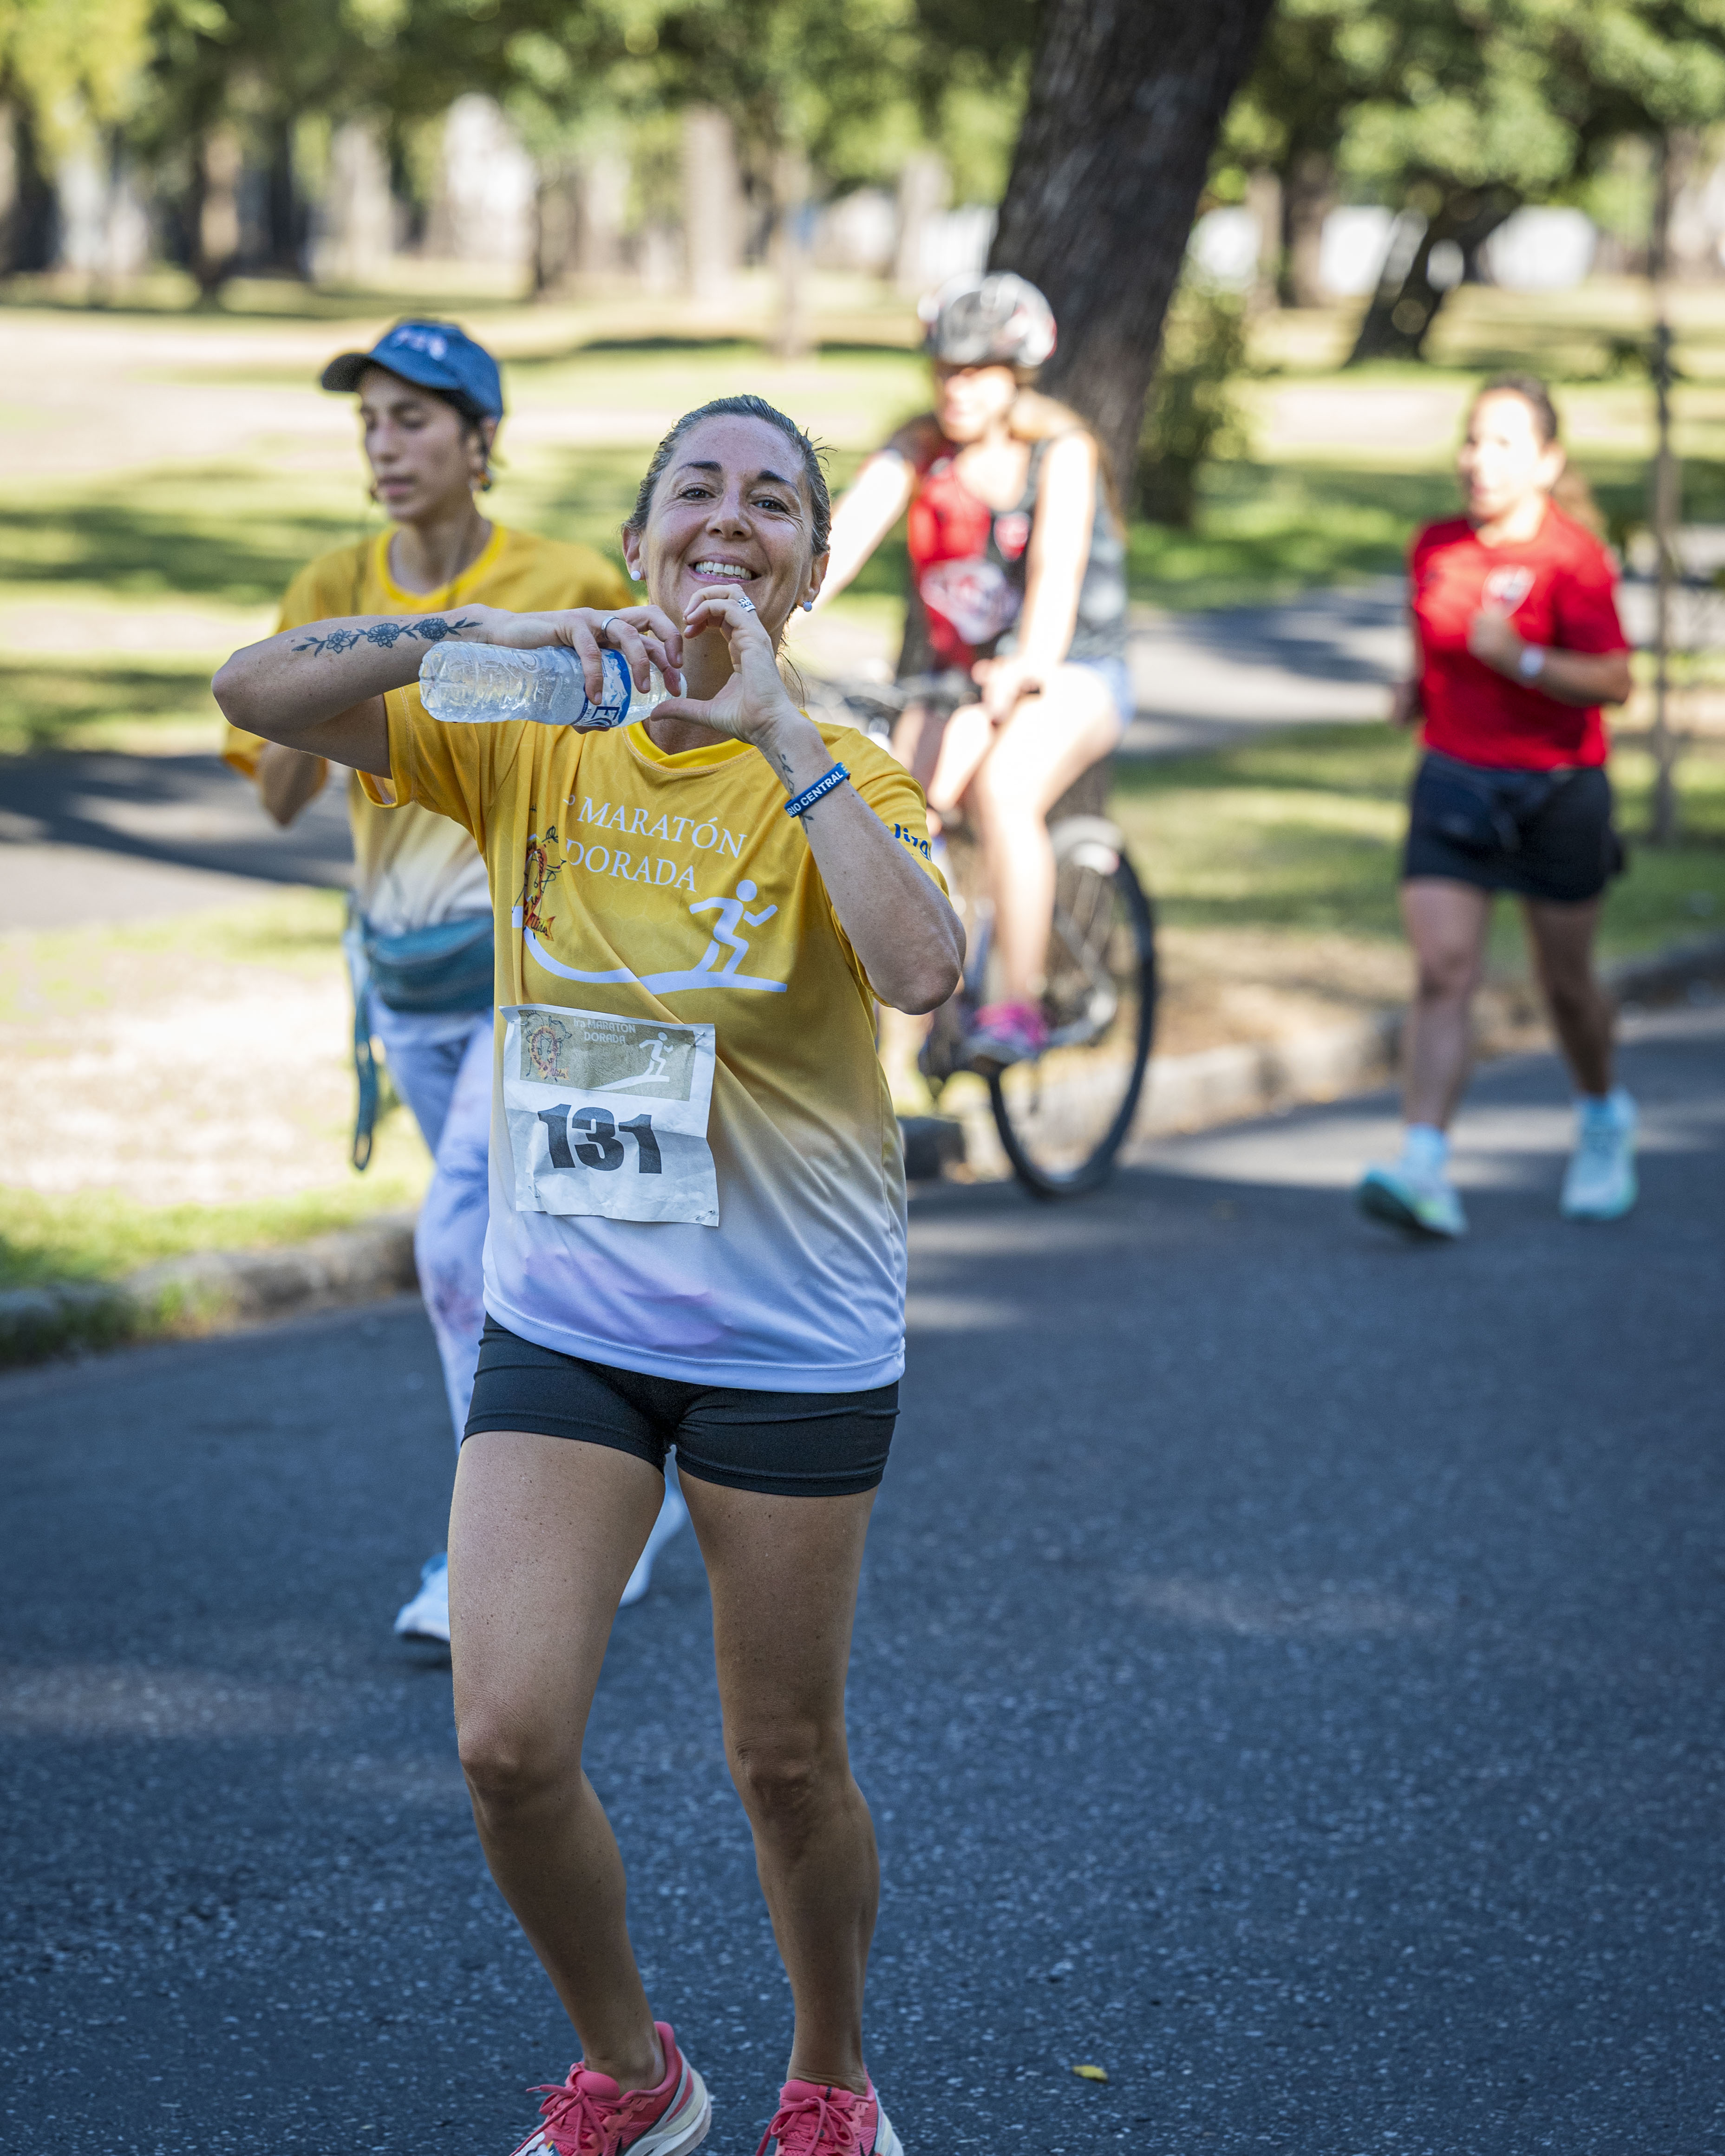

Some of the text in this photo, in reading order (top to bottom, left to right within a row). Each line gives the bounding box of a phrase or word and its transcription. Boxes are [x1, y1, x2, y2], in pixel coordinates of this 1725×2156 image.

[800, 771, 843, 806] CENTRAL
[577, 796, 747, 859] MARATÓN
[566, 838, 697, 892] DORADA
[584, 1031, 626, 1044] DORADA
[537, 1103, 662, 1174] 131
